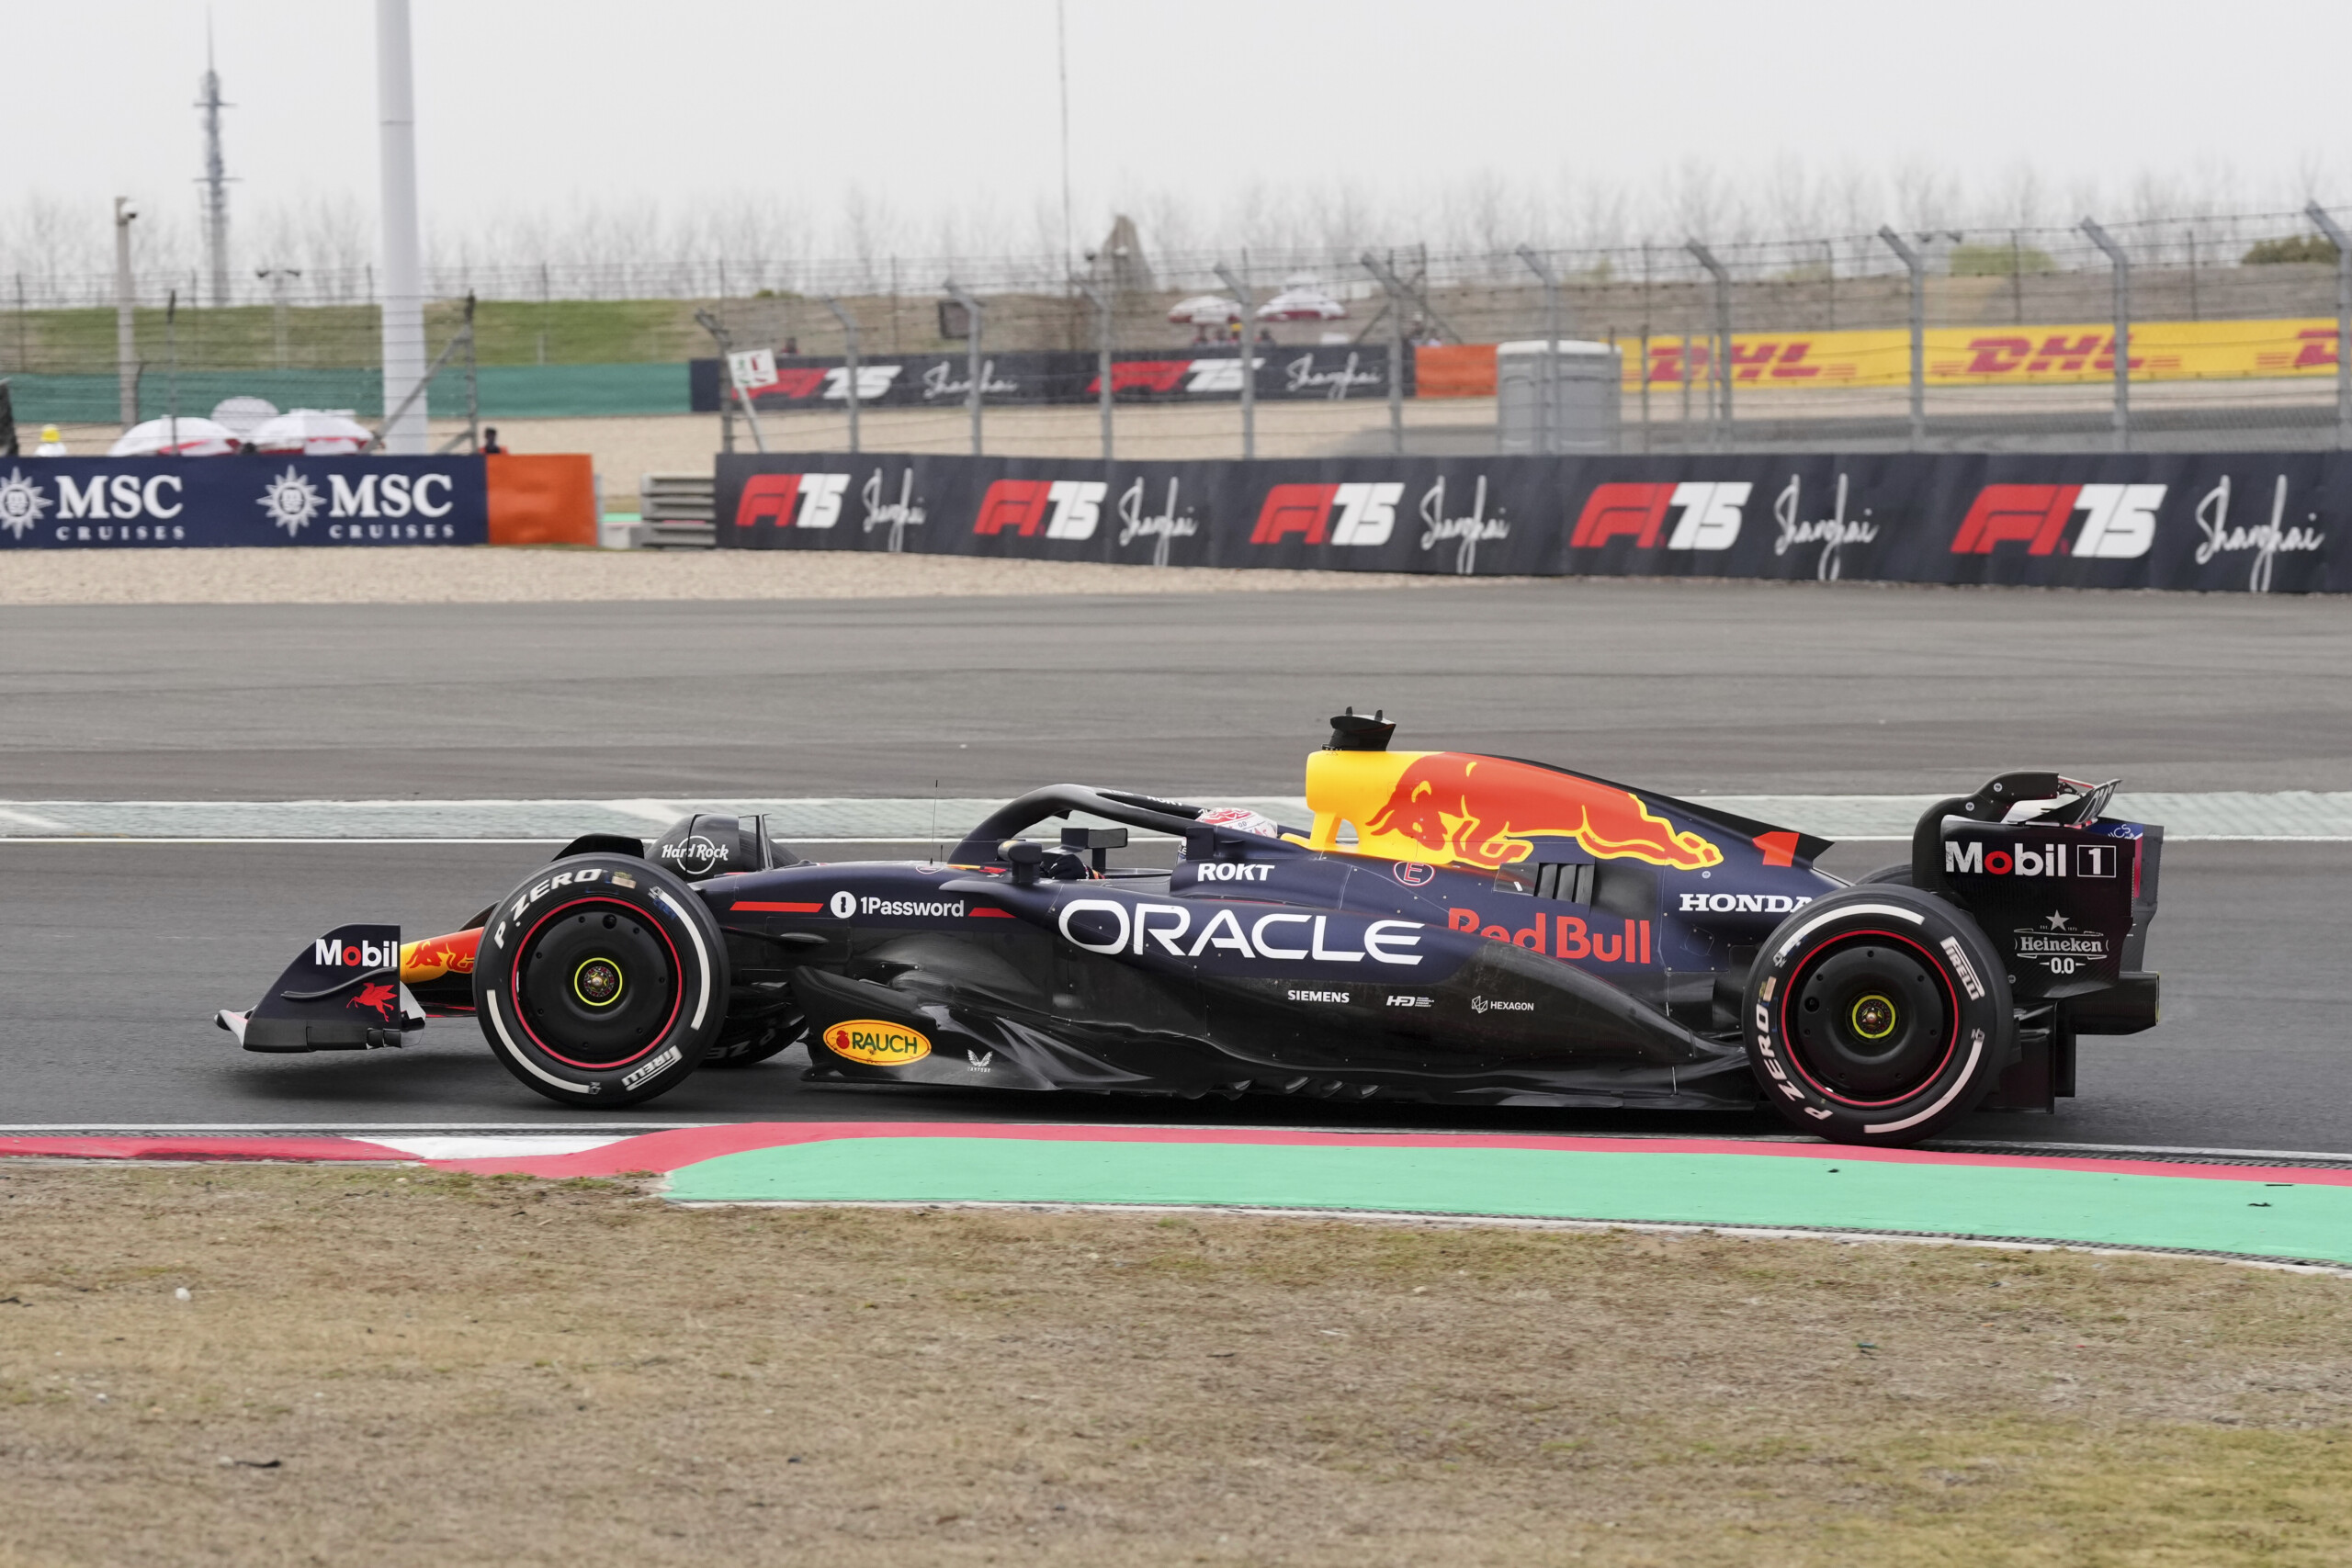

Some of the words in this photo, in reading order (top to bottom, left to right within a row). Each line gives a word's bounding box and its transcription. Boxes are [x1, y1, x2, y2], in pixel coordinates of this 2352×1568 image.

[1649, 342, 1822, 381] DHL
[1967, 333, 2145, 373] DHL
[55, 474, 184, 519] MSC
[326, 473, 453, 517] MSC
[55, 525, 185, 541] CRUISES
[328, 524, 455, 539] CRUISES
[1774, 473, 1880, 581] Shanghai
[2195, 474, 2326, 592] Shanghai
[662, 843, 696, 858] Hard
[696, 843, 729, 861] Rock
[1945, 840, 2067, 876] Mobil
[1197, 863, 1275, 882] ROKT
[1404, 863, 1424, 883] E
[510, 868, 603, 921] ZERO
[860, 897, 965, 917] 1Password
[1057, 898, 1425, 965] ORACLE
[1556, 915, 1651, 964] Bull
[2020, 936, 2102, 953] Heineken
[315, 938, 398, 968] Mobil
[1939, 935, 1985, 1001] PIRELLI
[2051, 957, 2075, 975] 0.0
[1287, 989, 1350, 1003] SIEMENS
[1490, 1001, 1534, 1011] HEXAGON
[852, 1031, 918, 1055] RAUCH
[1756, 1003, 1805, 1101] ZERO
[621, 1044, 684, 1091] PIRELLI
